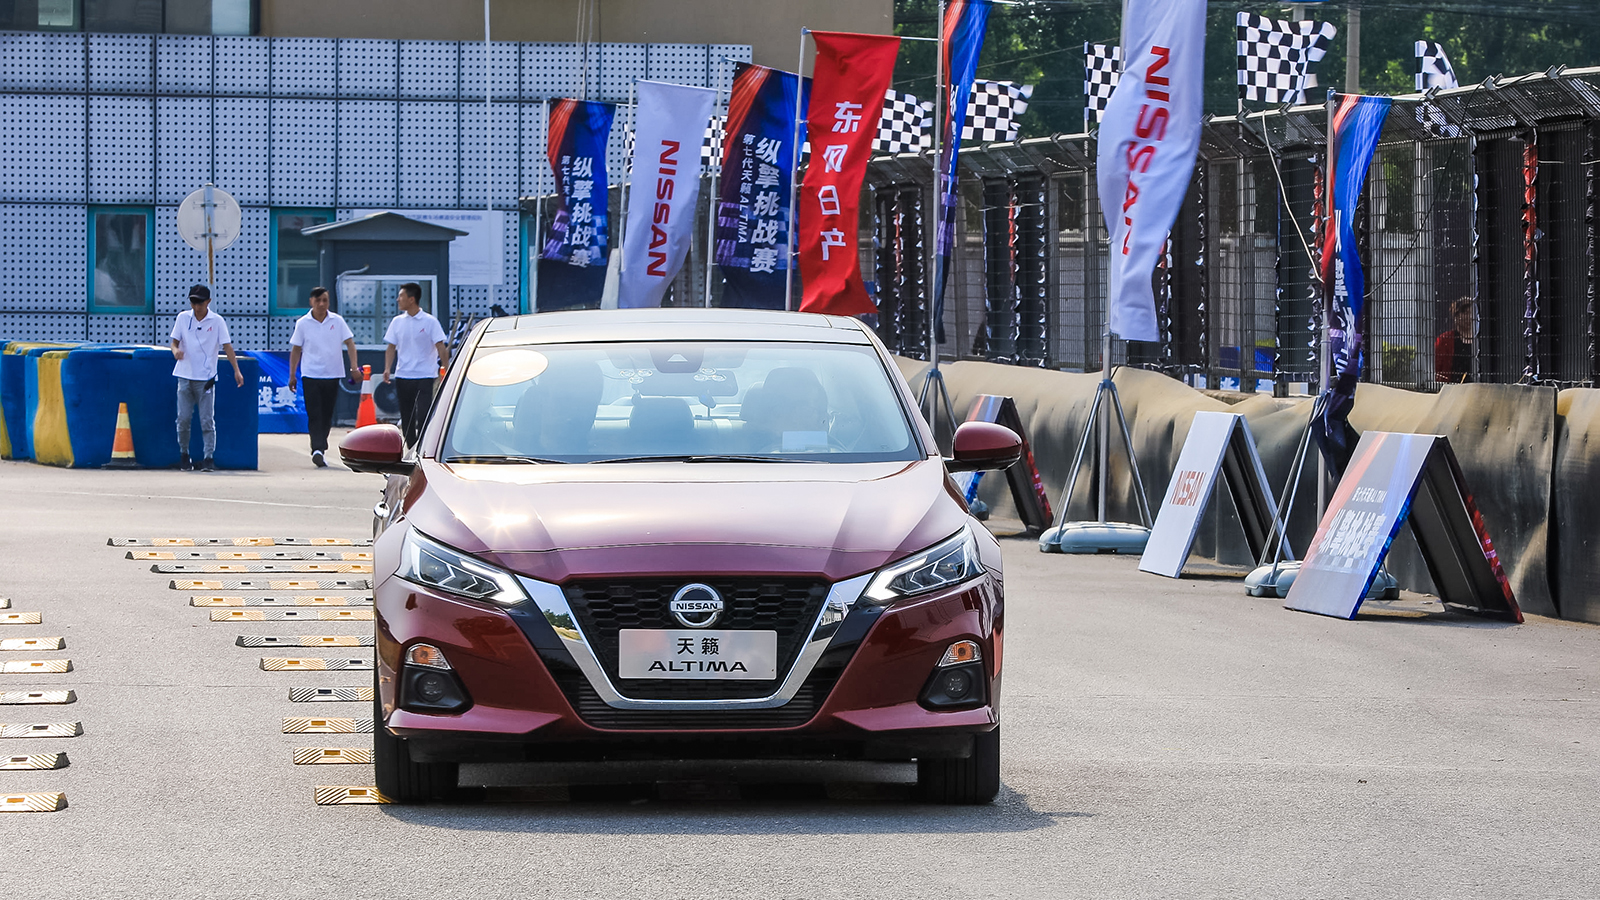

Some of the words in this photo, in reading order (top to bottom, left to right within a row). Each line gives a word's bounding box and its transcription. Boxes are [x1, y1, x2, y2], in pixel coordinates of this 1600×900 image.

[1122, 46, 1170, 255] NISSAN
[750, 137, 782, 274] 纵擎挑战赛
[817, 101, 862, 260] 东风日产
[568, 157, 594, 268] 纵擎挑战赛
[646, 140, 681, 277] NISSAN
[738, 195, 750, 243] ALTIMA
[1169, 470, 1206, 506] NISSAN
[1318, 508, 1387, 559] 纵擎挑战赛
[676, 602, 718, 610] NISSAN
[648, 660, 748, 672] ALTIMA
[677, 637, 719, 655] 天籁
